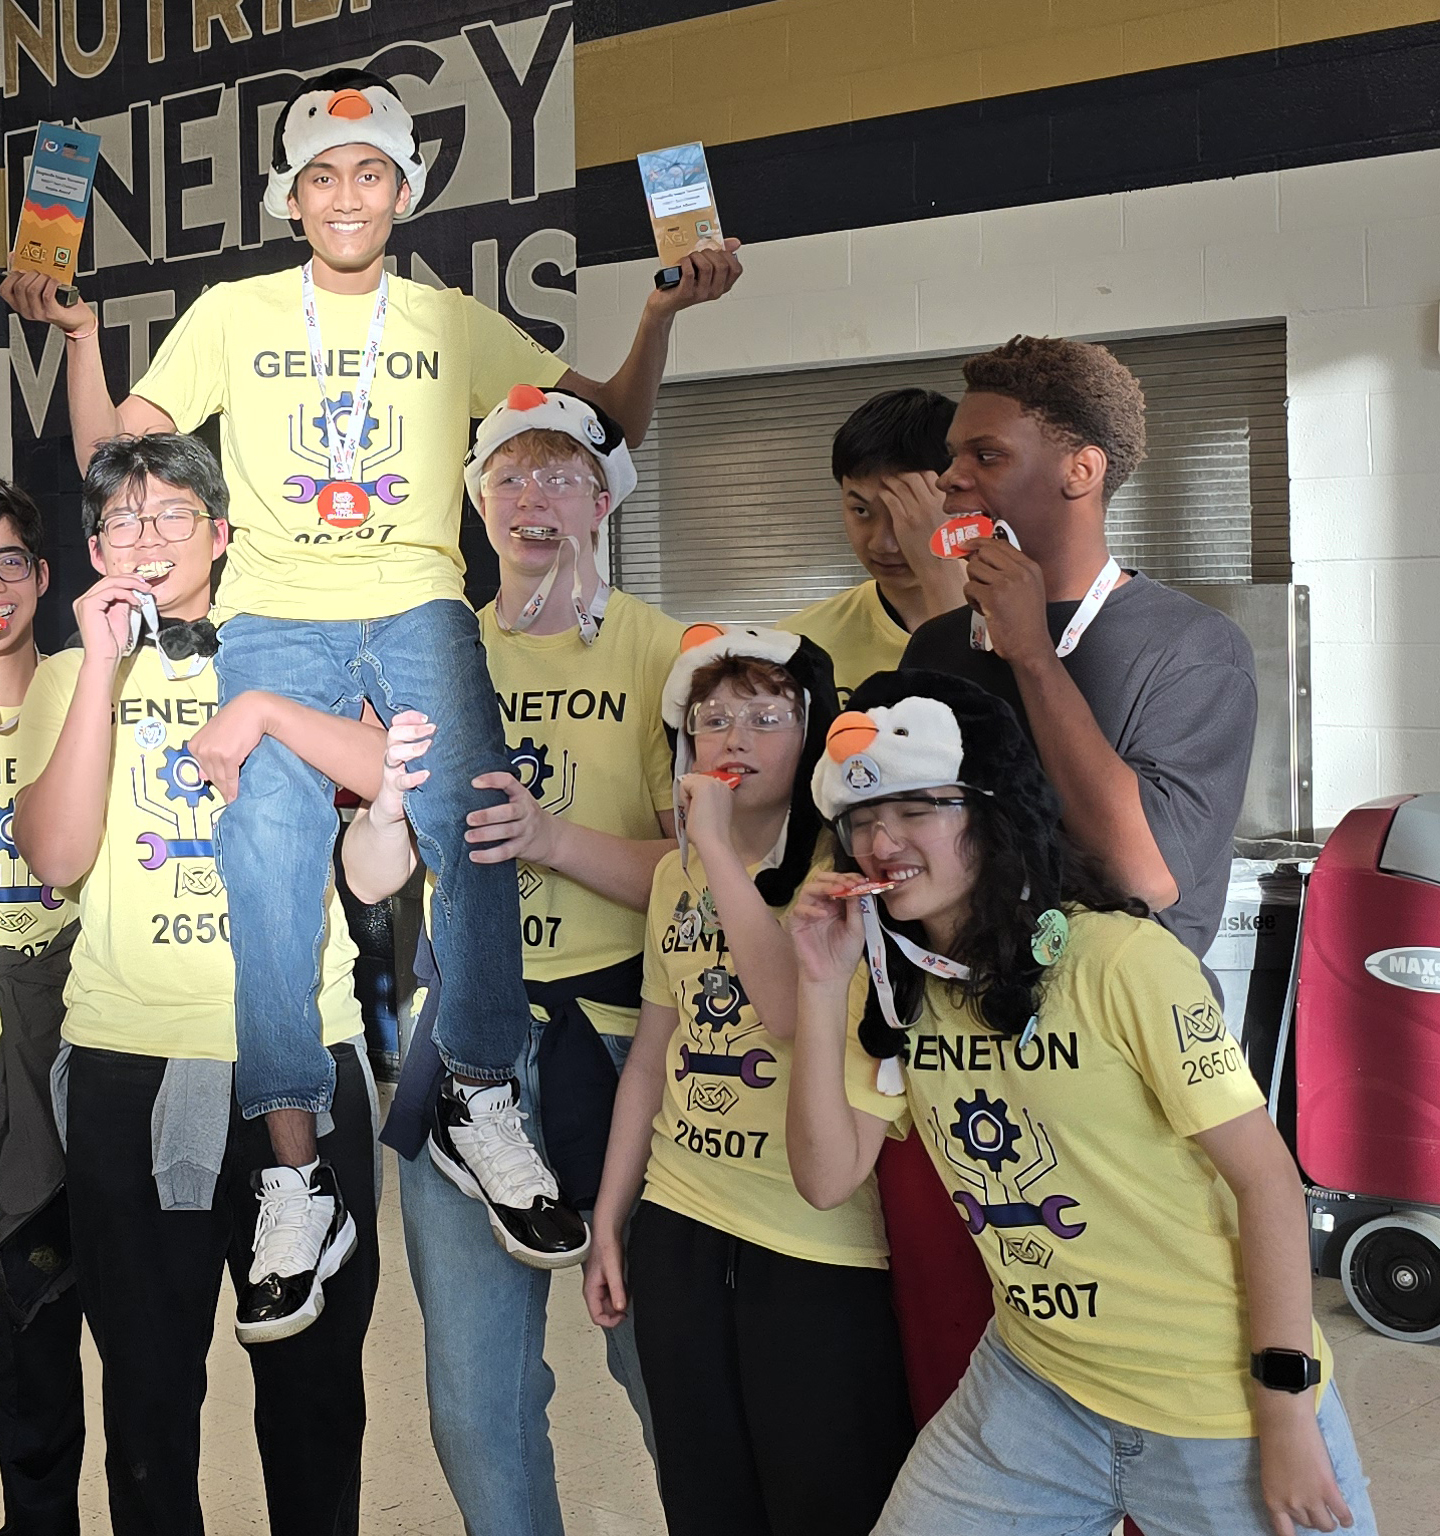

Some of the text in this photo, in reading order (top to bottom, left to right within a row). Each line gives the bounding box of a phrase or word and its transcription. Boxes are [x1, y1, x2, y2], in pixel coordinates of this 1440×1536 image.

[111, 697, 219, 725] ENET
[495, 688, 627, 723] NETON
[151, 912, 230, 945] 2650
[904, 1031, 1080, 1072] ENETON
[1182, 1046, 1242, 1086] 26507
[673, 1119, 769, 1159] 26507
[1004, 1281, 1099, 1320] 6507
